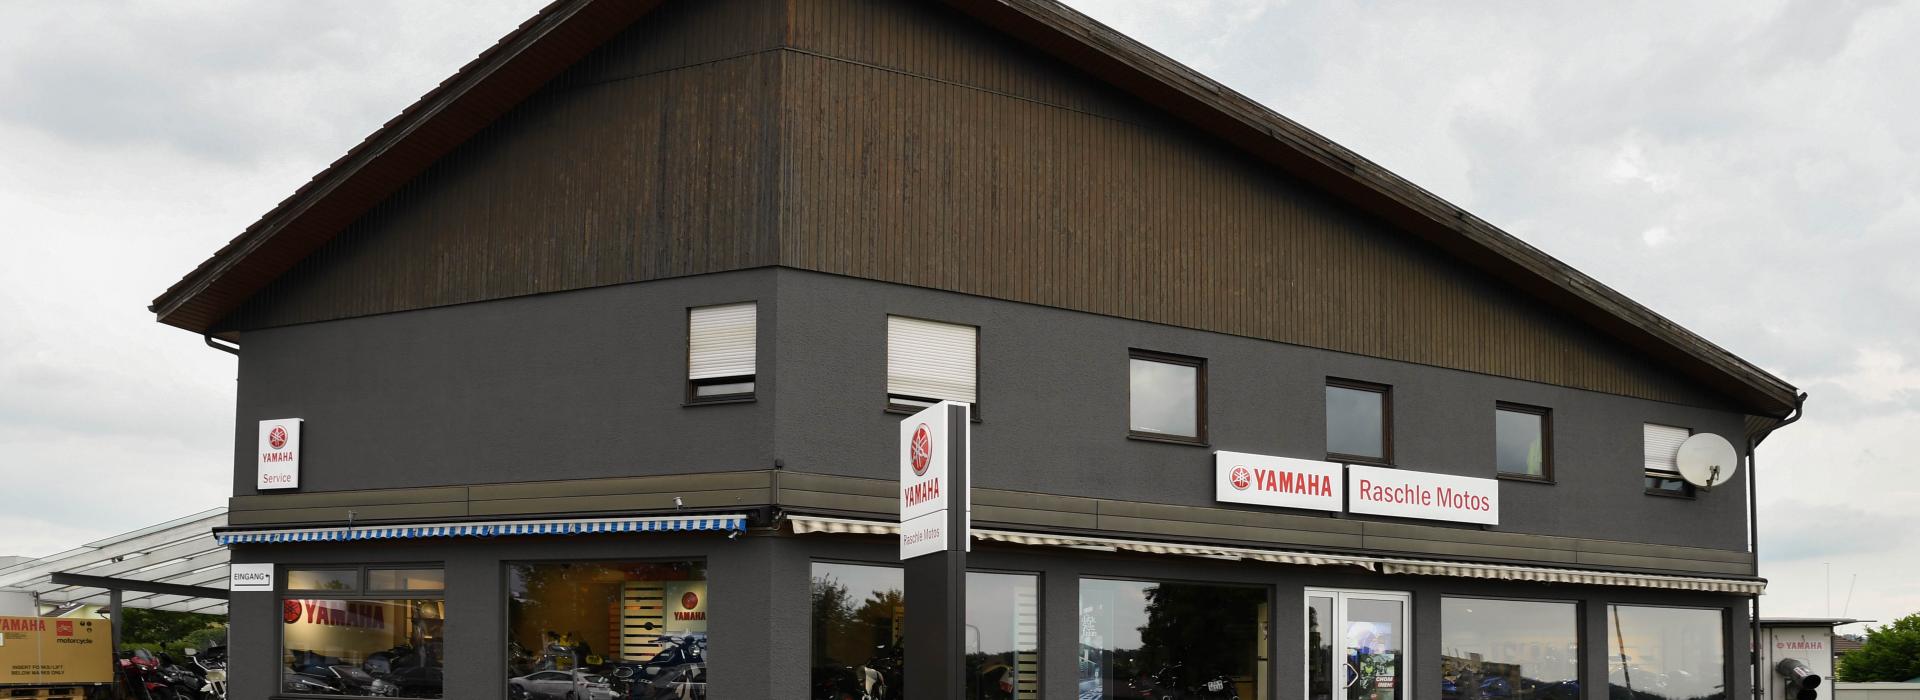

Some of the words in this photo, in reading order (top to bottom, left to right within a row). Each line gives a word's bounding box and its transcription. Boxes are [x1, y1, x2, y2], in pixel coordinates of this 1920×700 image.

[262, 451, 293, 463] YAMAHA
[263, 473, 292, 484] Service
[1254, 468, 1332, 497] YAMAHA
[904, 477, 940, 508] YAMAHA
[1359, 479, 1431, 506] Raschle
[1436, 487, 1490, 512] Motos
[903, 530, 923, 546] Raschle
[923, 528, 940, 540] Motos
[234, 572, 265, 581] EINGANG
[305, 600, 385, 629] YAMAHA
[674, 611, 706, 621] YAMAHA
[1786, 642, 1823, 650] YAMAHA
